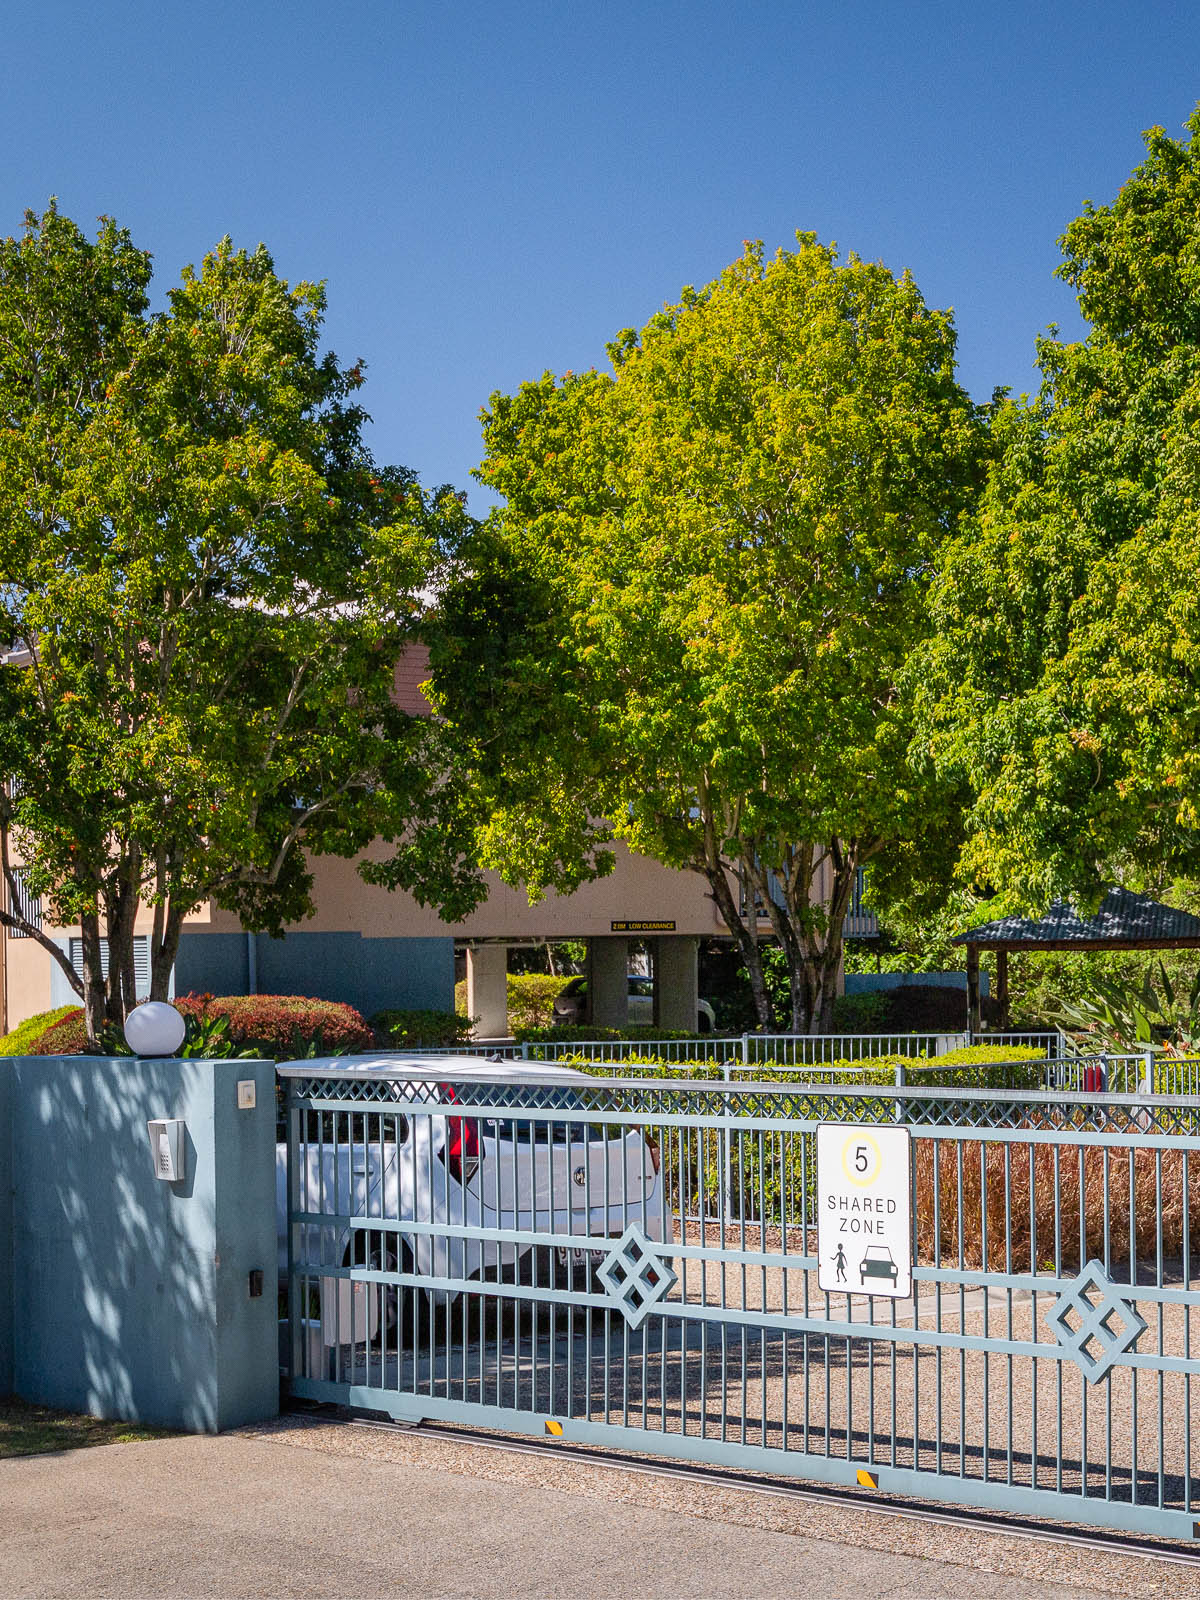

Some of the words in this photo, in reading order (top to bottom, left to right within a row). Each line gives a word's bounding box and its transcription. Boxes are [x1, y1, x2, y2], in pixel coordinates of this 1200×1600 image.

[628, 922, 642, 930] LOW
[855, 1146, 868, 1172] 5
[827, 1195, 897, 1214] SHARED
[839, 1217, 885, 1235] ZONE
